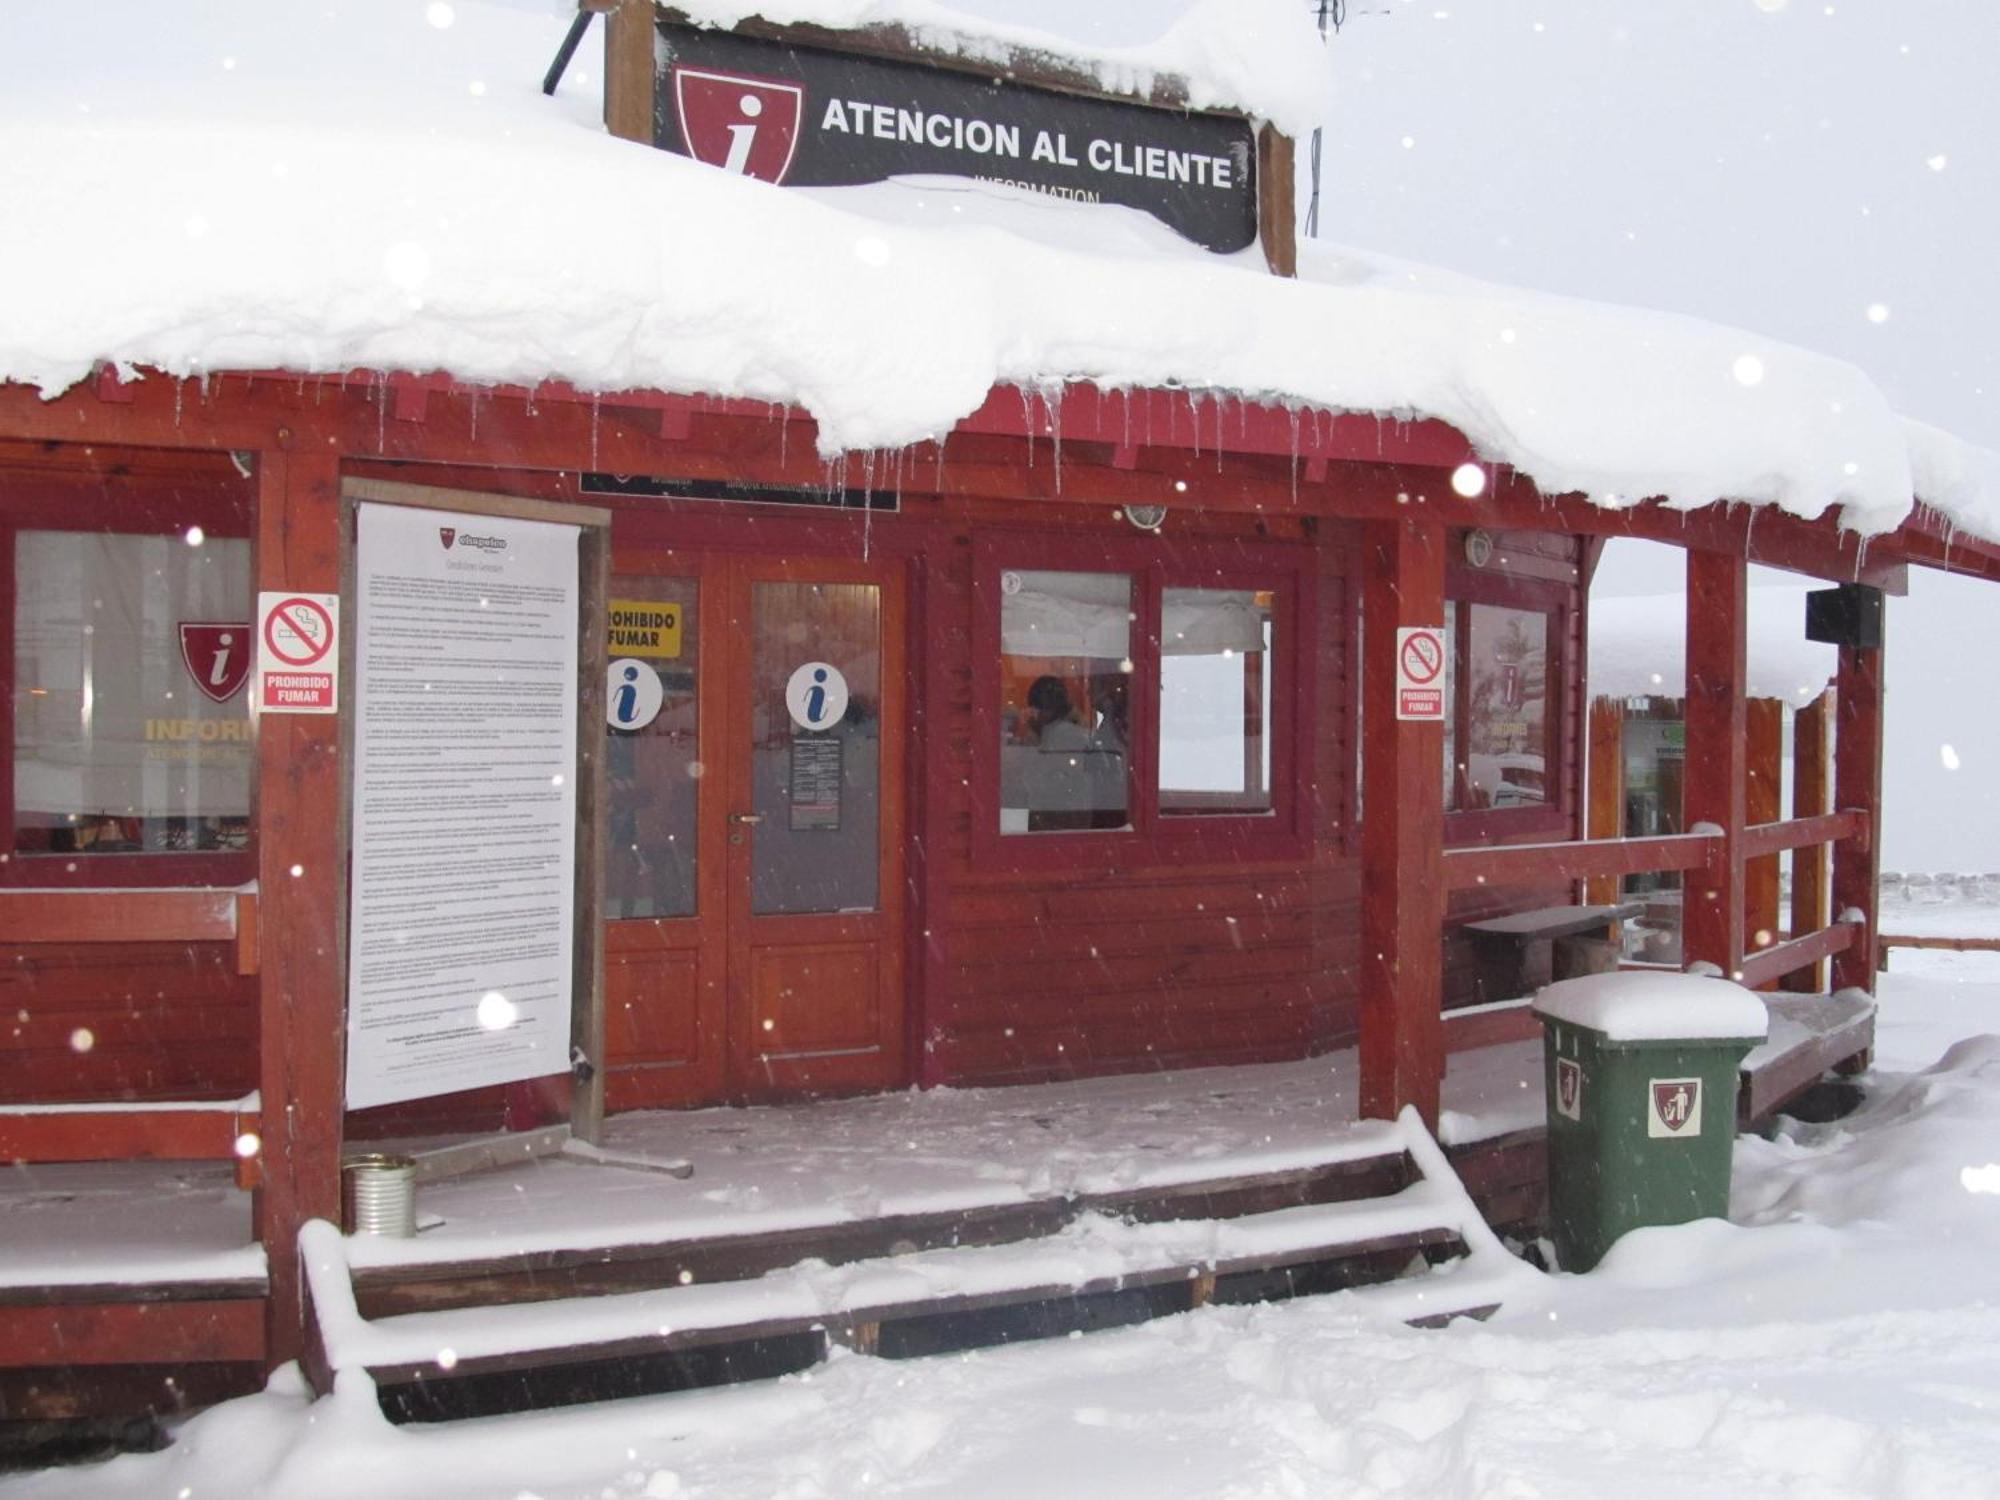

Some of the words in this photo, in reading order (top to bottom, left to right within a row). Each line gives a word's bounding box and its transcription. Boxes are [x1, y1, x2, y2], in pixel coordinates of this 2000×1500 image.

[820, 98, 1020, 158] ATENCION
[1031, 130, 1079, 167] AL
[1087, 139, 1233, 189] CLIENTE
[608, 610, 676, 630] OHIBIDO
[608, 630, 660, 647] FUMAR
[267, 675, 330, 689] PROHIBIDO
[277, 689, 320, 703] FUMAR
